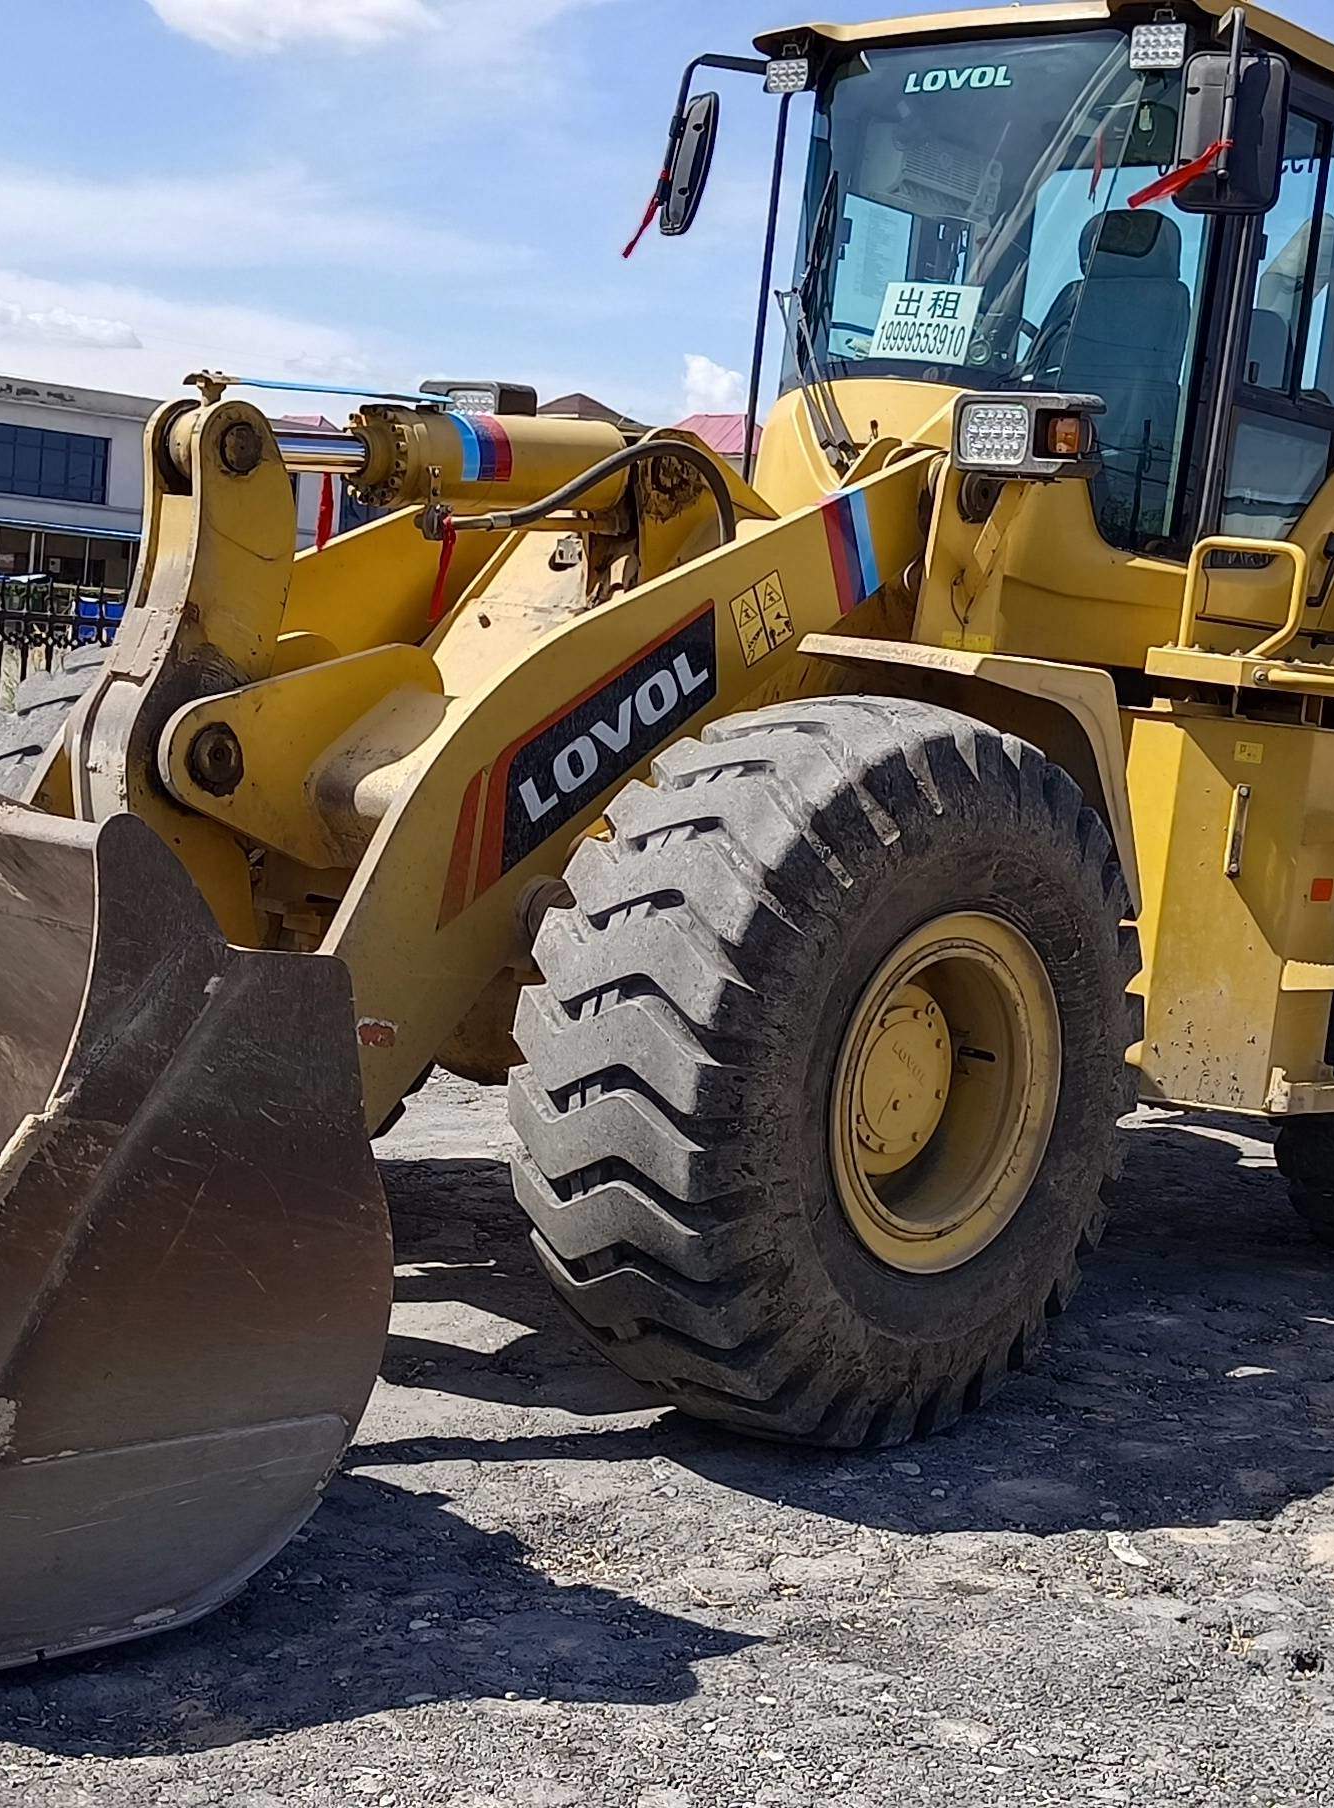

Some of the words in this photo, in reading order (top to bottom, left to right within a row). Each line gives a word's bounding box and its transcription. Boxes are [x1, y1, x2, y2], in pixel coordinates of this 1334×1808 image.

[904, 65, 1012, 94] LOVOL
[894, 287, 962, 319] 出租
[877, 320, 965, 357] 19999553910
[518, 652, 709, 822] LOVOL
